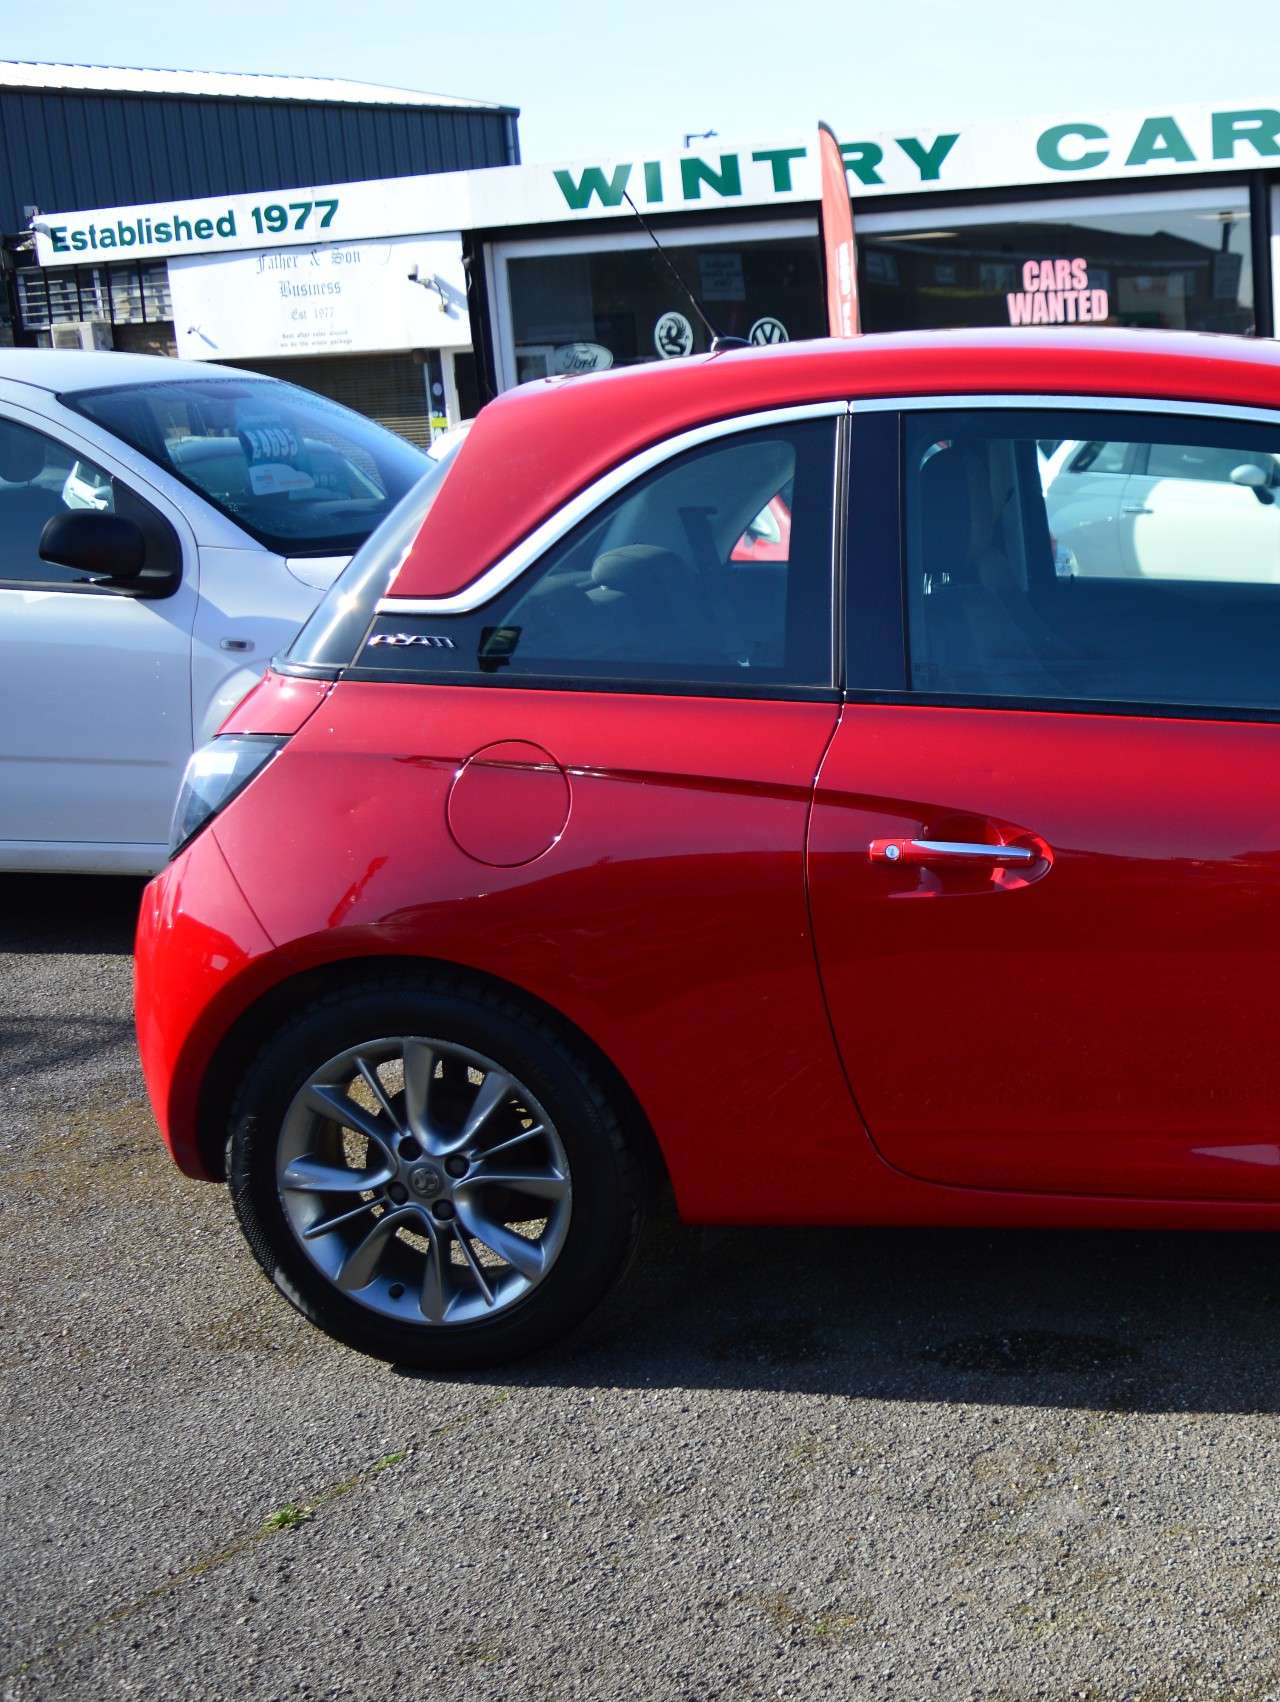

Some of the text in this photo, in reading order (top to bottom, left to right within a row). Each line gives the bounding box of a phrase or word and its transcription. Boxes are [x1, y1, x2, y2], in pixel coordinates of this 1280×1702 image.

[552, 133, 960, 211] WINTRY
[50, 199, 339, 253] Established 1977
[256, 247, 361, 274] Father & Son
[1022, 257, 1089, 292] CARS
[278, 280, 341, 298] Business
[1007, 289, 1109, 326] WANTED
[563, 351, 599, 369] Ford
